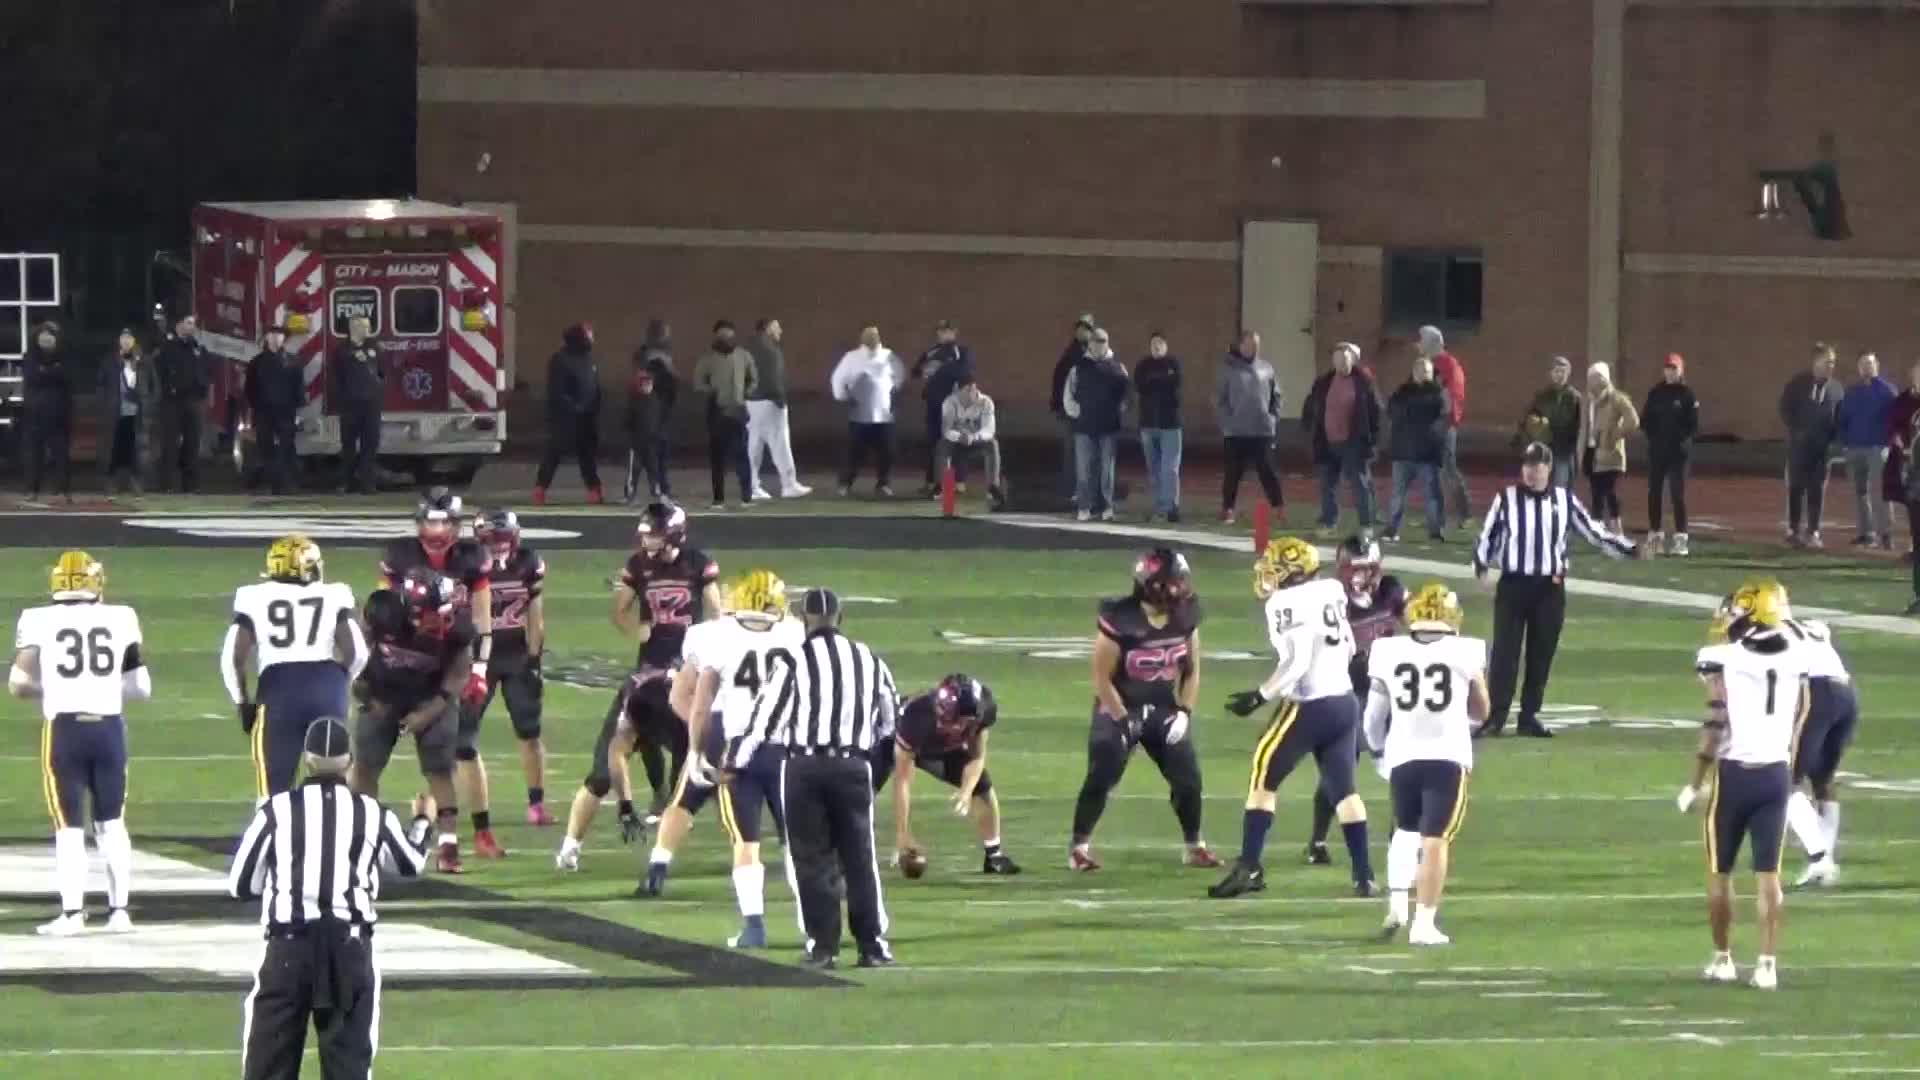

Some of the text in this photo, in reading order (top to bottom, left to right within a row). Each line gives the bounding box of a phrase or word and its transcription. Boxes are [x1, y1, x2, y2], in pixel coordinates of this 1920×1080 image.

[335, 264, 368, 278] CITY
[386, 263, 440, 277] MASON
[335, 302, 375, 318] FDNY
[267, 596, 325, 649] 97
[55, 627, 115, 679] 36
[1393, 662, 1453, 712] 33
[1765, 668, 1778, 716] 1
